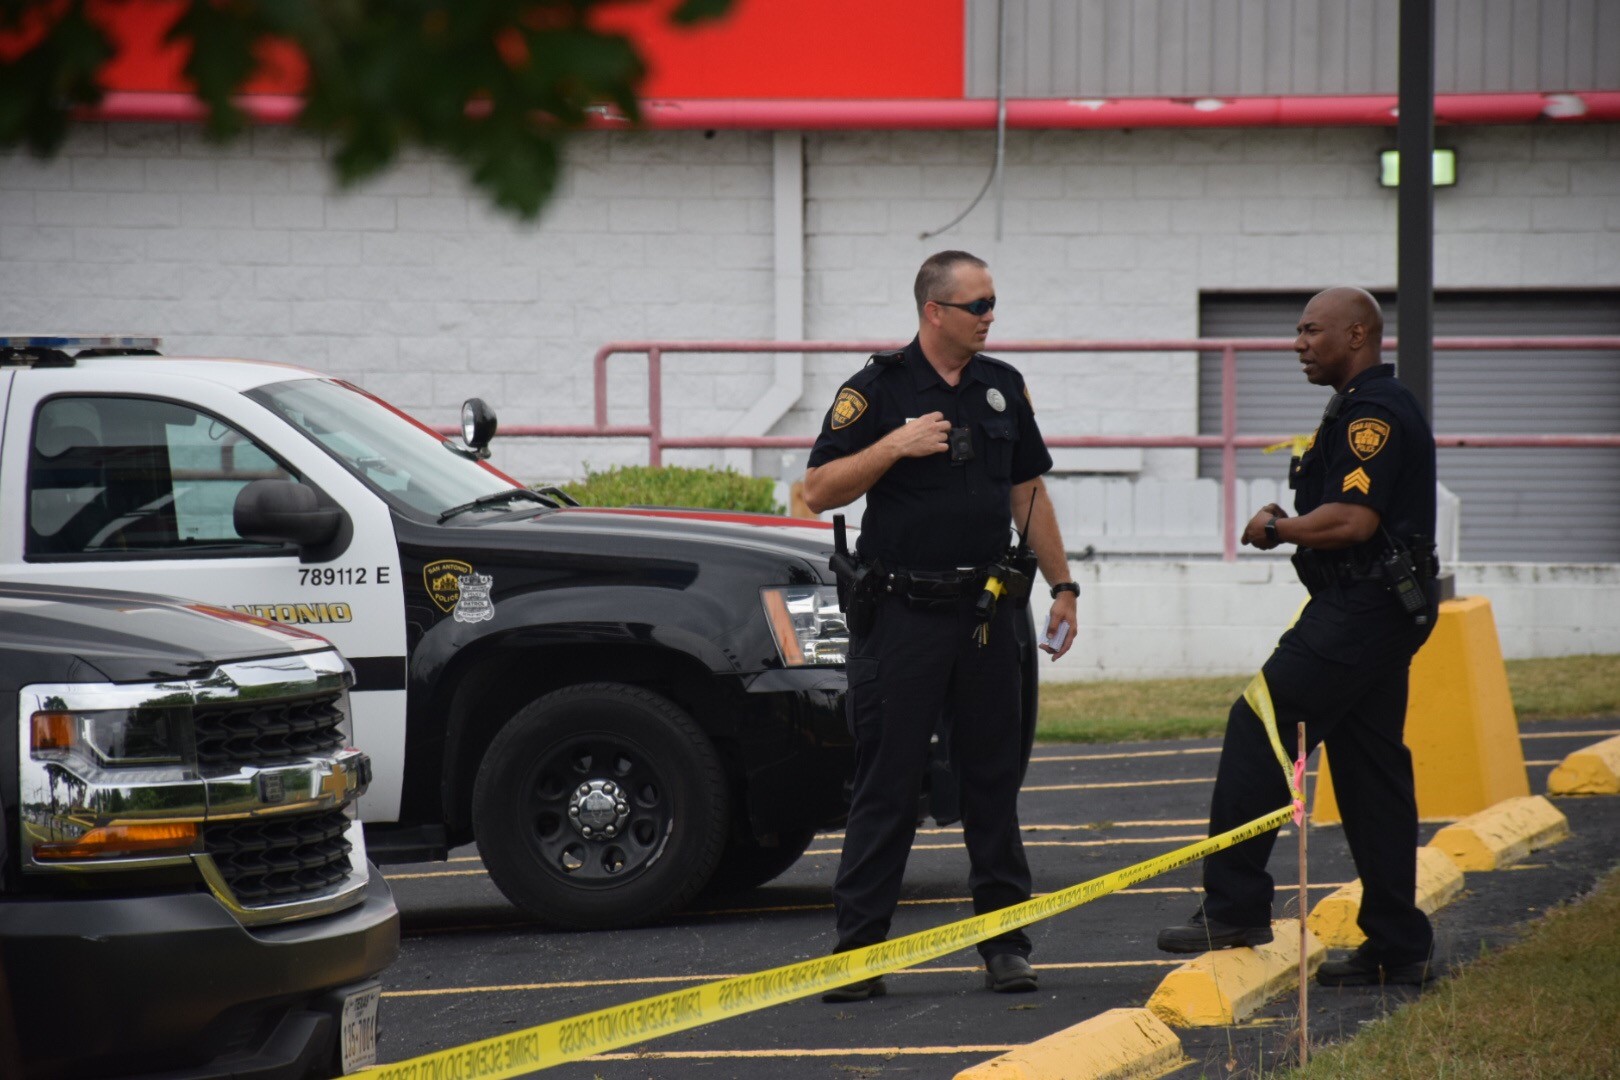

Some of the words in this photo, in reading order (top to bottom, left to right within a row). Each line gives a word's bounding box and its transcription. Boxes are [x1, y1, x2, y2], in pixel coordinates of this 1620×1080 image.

[298, 568, 367, 586] 789112
[376, 566, 390, 584] E
[428, 566, 440, 574] SAN
[442, 564, 468, 573] ANTONIO
[435, 593, 458, 602] POLICE
[220, 602, 353, 624] TONIO
